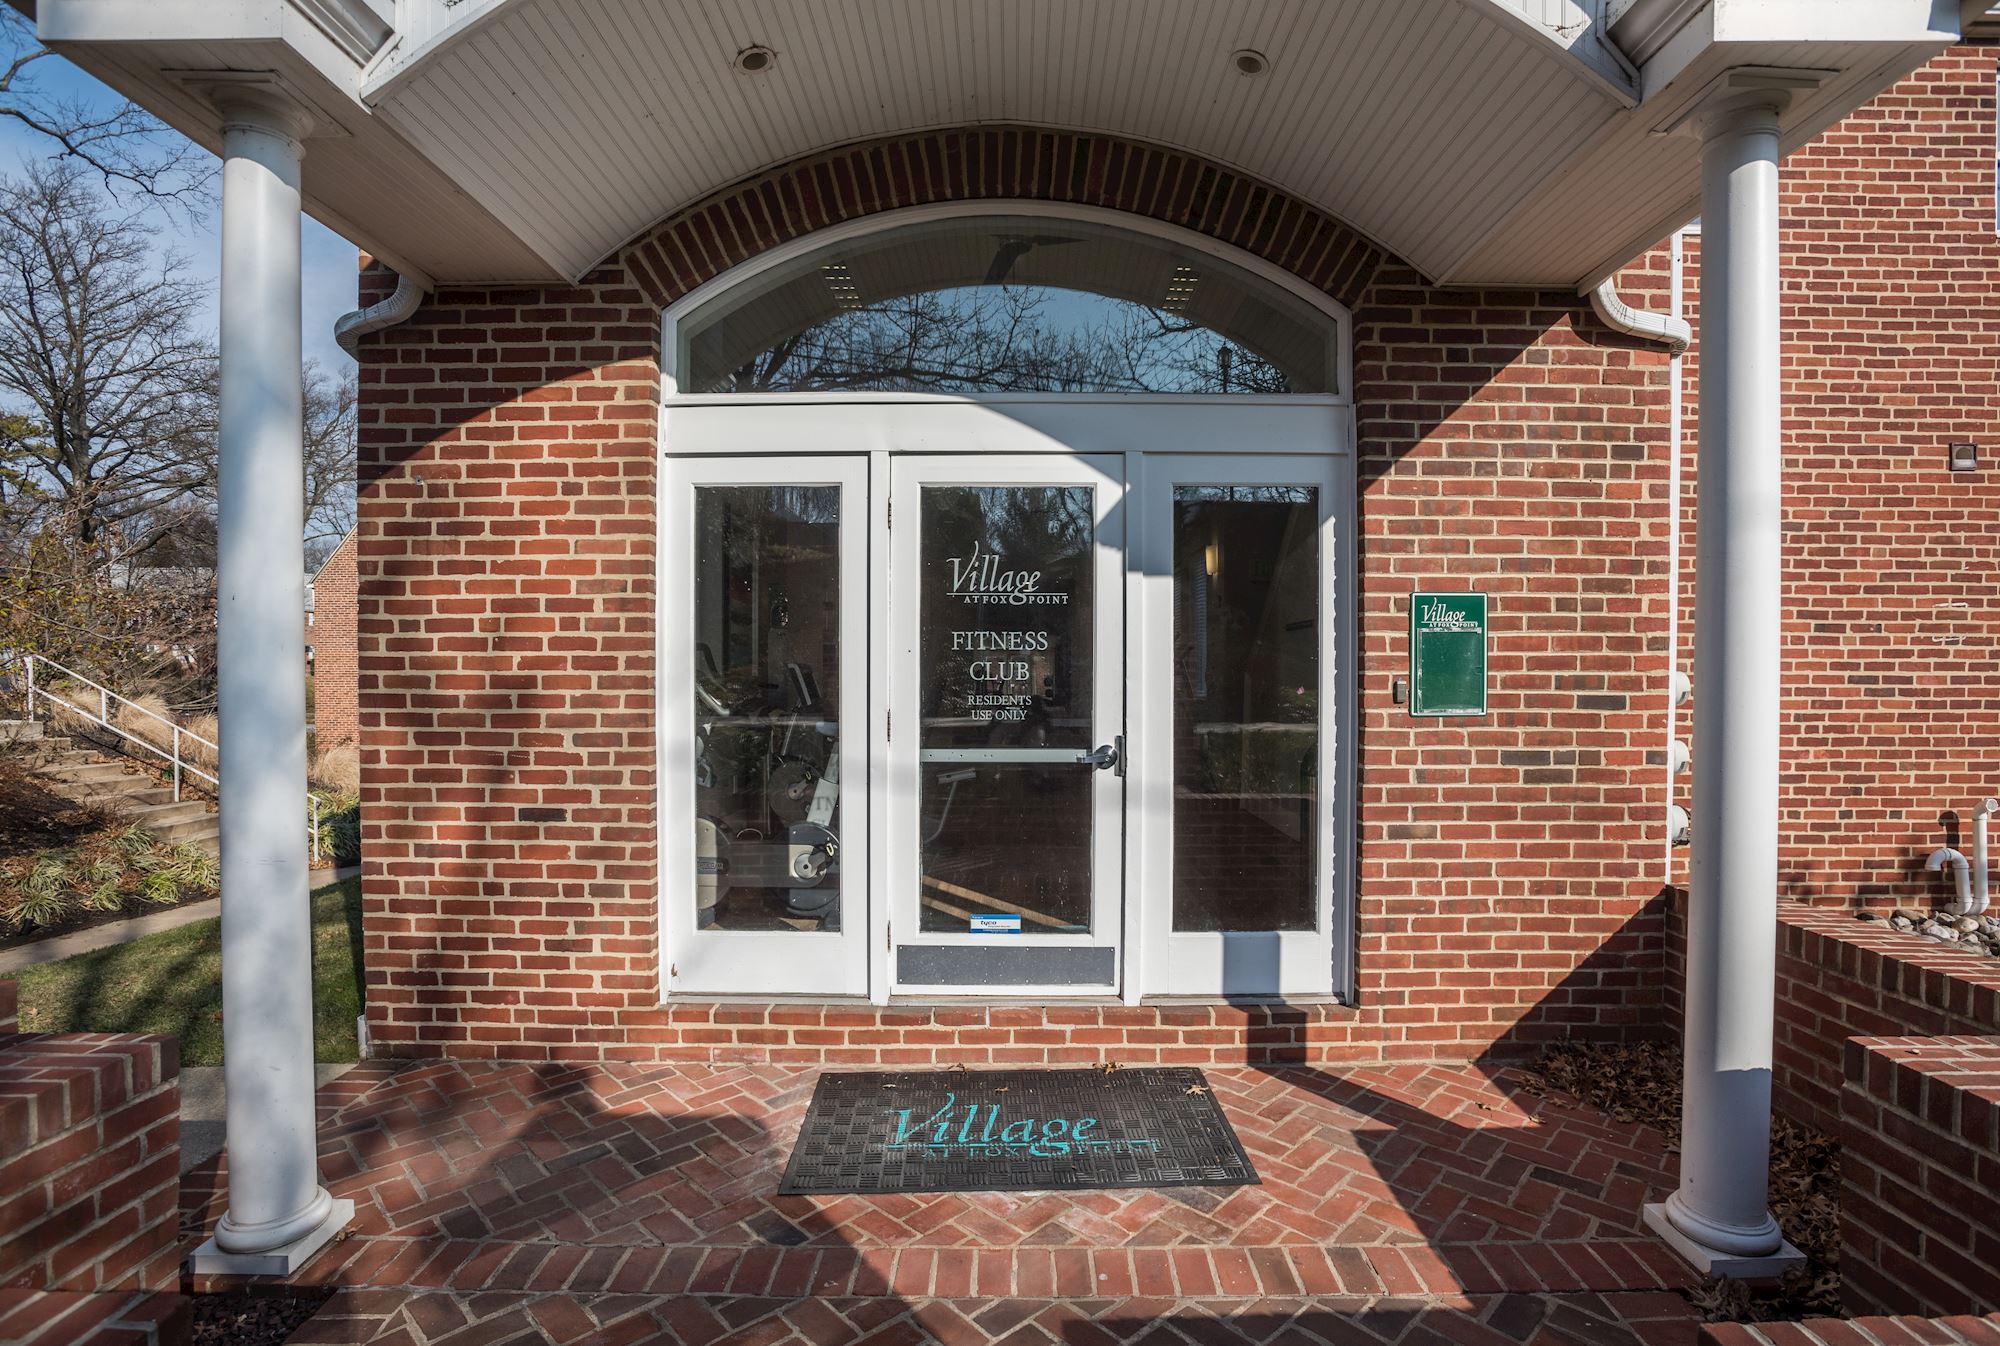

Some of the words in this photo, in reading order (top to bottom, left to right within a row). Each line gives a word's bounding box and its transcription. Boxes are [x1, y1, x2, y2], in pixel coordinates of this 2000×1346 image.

[946, 540, 1041, 605] Village
[964, 596, 980, 604] AT
[983, 596, 1007, 604] FOX
[1028, 596, 1069, 604] POINT
[1421, 597, 1466, 627] Village
[951, 631, 1048, 650] FITNESS
[969, 661, 1030, 681] CLUB
[967, 695, 1032, 706] RESIDENTS
[971, 710, 993, 721] USE
[995, 710, 1028, 721] ONLY
[883, 1092, 1097, 1157] Village
